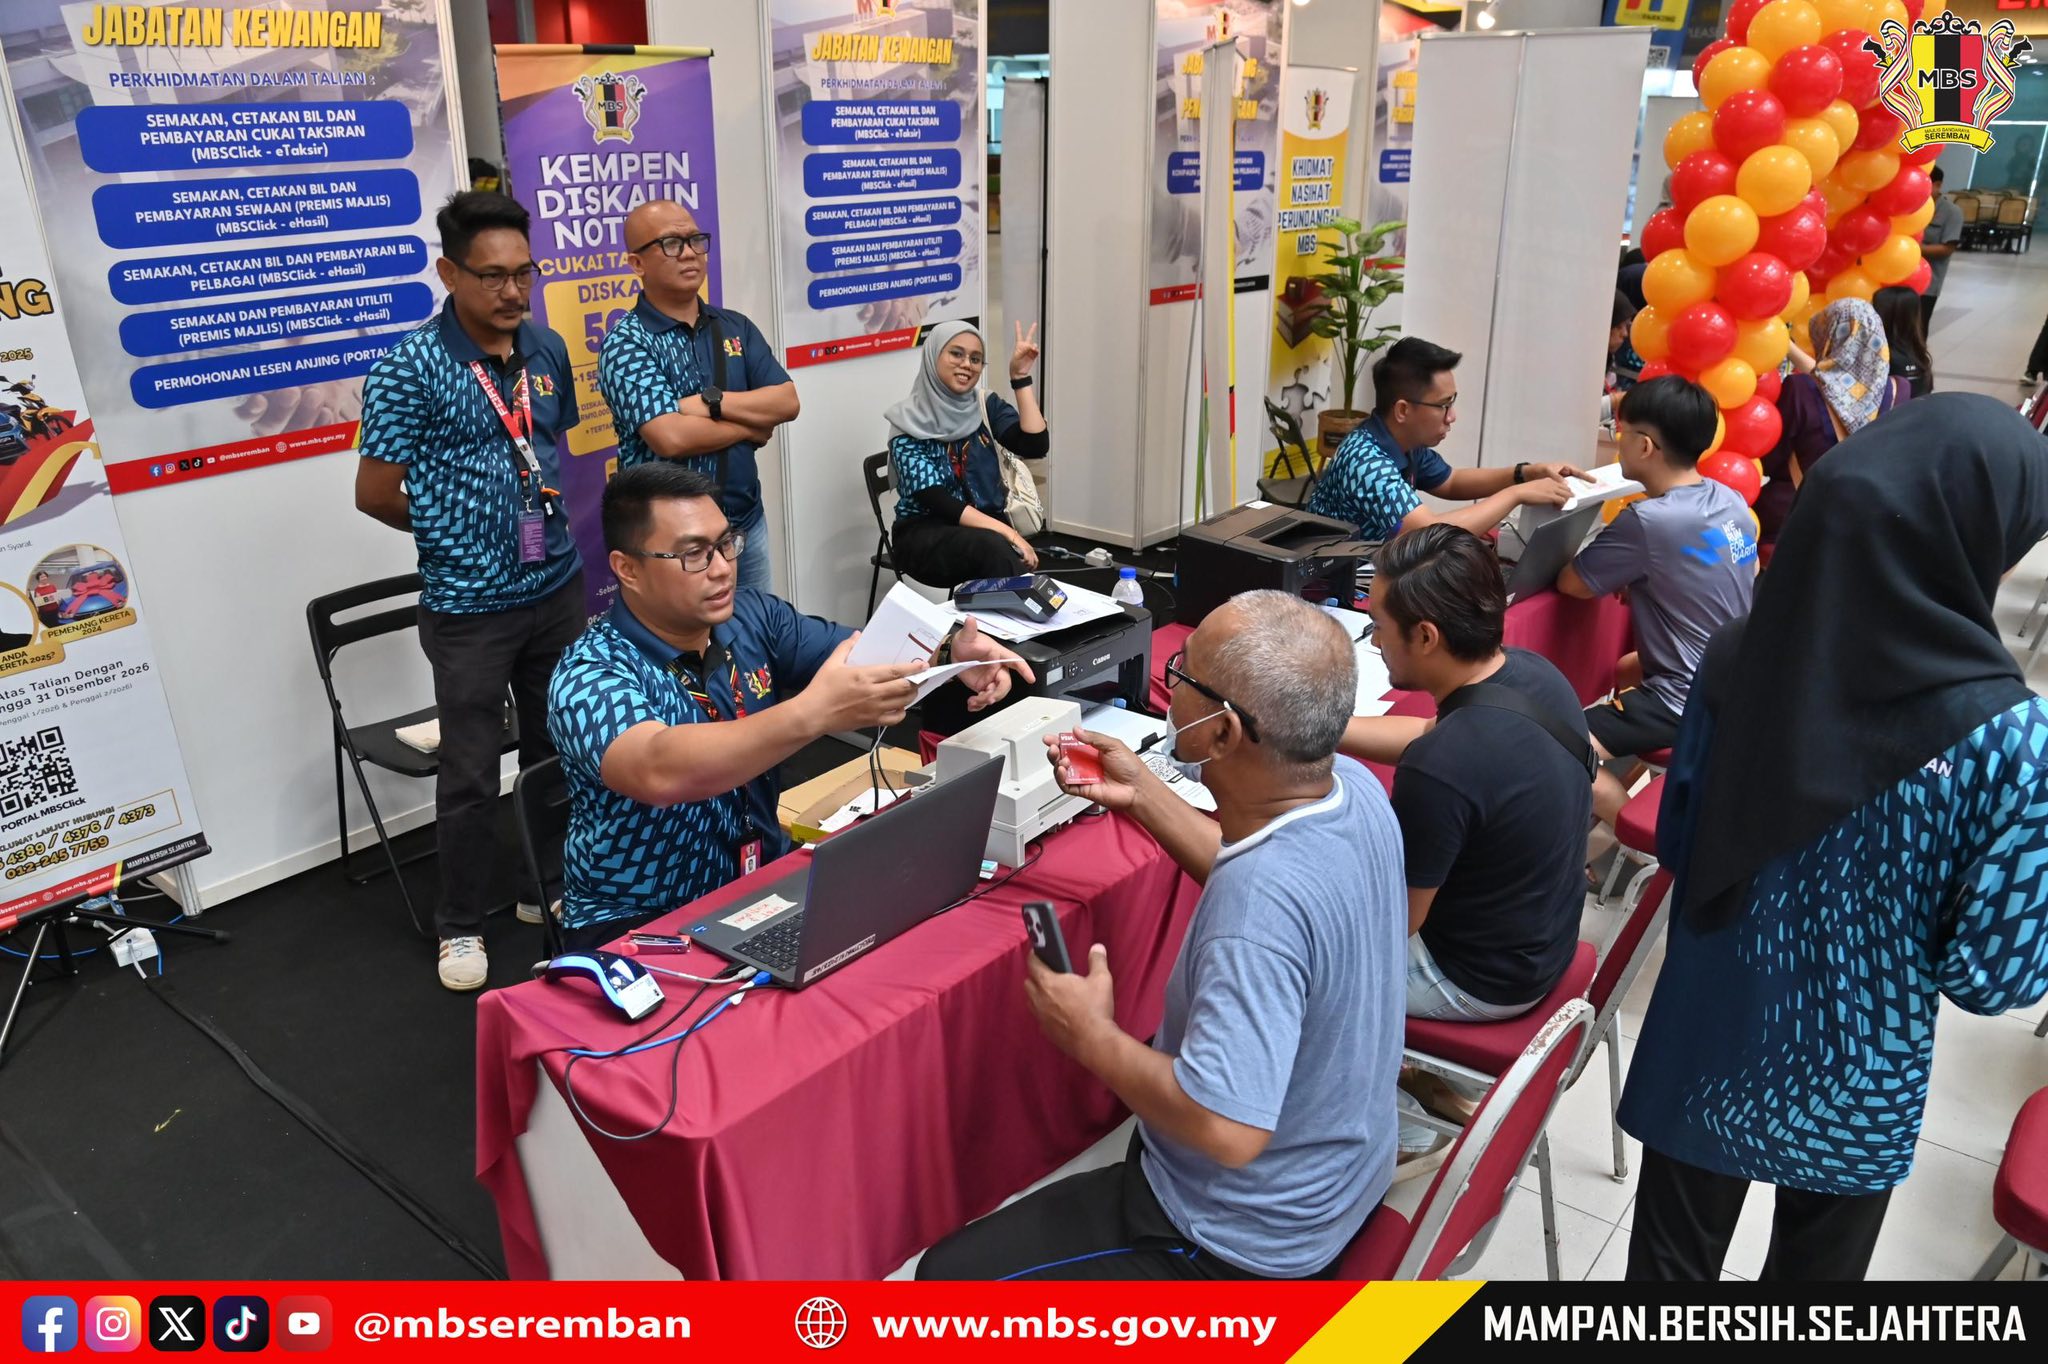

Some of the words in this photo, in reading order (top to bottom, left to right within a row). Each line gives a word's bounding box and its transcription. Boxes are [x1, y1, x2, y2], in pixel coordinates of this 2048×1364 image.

[82, 4, 223, 46] JABATAN
[232, 8, 382, 48] KEWANGAN
[813, 33, 879, 62] JABATAN
[882, 36, 953, 65] KEWANGAN
[110, 72, 246, 88] PERKHIDMATAN
[251, 72, 306, 86] DALAM
[313, 71, 367, 85] TALIAN
[821, 79, 885, 90] PERKHIDMATAN
[597, 100, 624, 112] MBS
[835, 105, 876, 117] SEMAKAN,
[877, 105, 908, 116] CETAKAN
[910, 105, 920, 115] BIL
[921, 106, 936, 116] DAN
[146, 113, 228, 128] SEMAKAN,
[232, 111, 300, 125] CETAKAN
[304, 110, 324, 123] BIL
[327, 110, 356, 122] DAN
[831, 117, 883, 128] PEMBAYARAN
[885, 117, 906, 127] CUKAI
[907, 116, 939, 127] TAKSIRAN
[140, 130, 248, 145] PEMBAYARAN
[251, 128, 295, 142] CUKAI
[298, 125, 365, 139] TAKSIRAN
[191, 147, 262, 164] (MBSClick
[275, 144, 329, 159] eTaksir)
[842, 159, 878, 169] SEMAKAN,
[879, 157, 908, 167] CETAKAN
[909, 157, 918, 165] BIL
[918, 156, 932, 165] DAN
[540, 152, 690, 186] KEMPEN
[823, 169, 871, 181] PEMBAYARAN
[873, 168, 900, 179] SEWAAN
[1293, 158, 1333, 177] KHIDMAT
[172, 188, 244, 204] SEMAKAN,
[247, 185, 307, 198] CETAKAN
[310, 183, 328, 195] BIL
[330, 182, 356, 193] DAN
[1291, 184, 1331, 202] NASIHAT
[135, 205, 232, 224] PEMBAYARAN
[235, 202, 292, 216] SEWAAN
[295, 199, 343, 214] (PREMIS
[346, 195, 391, 209] MAJLIS)
[812, 210, 850, 221] SEMAKAN,
[851, 207, 882, 217] CETAKAN
[883, 206, 892, 215] BIL
[893, 205, 907, 214] DAN
[908, 203, 947, 213] PEMBAYARAN
[948, 202, 956, 210] BIL
[216, 219, 277, 237] (MBSClick
[289, 214, 329, 229] eHasil)
[554, 215, 627, 250] NOT
[845, 219, 878, 230] PELBAGAI
[832, 245, 865, 256] SEMAKAN
[866, 244, 881, 253] DAN
[882, 240, 923, 252] PEMBAYARAN
[1297, 234, 1316, 253] MBS
[123, 264, 197, 282] SEMAKAN,
[200, 259, 262, 274] CETAKAN
[265, 255, 283, 268] BIL
[286, 252, 313, 266] DAN
[316, 245, 396, 263] PEMBAYARAN
[399, 243, 415, 255] BIL
[537, 254, 604, 277] CUKAI
[190, 276, 255, 291] PELBAGAI
[258, 269, 317, 287] (MBSClick
[328, 263, 366, 277] eHasil)
[578, 279, 642, 304] DISKA
[819, 284, 868, 298] PERMOHONAN
[869, 281, 889, 293] LESEN
[890, 279, 913, 290] ANJING
[0, 278, 54, 321] NG
[170, 312, 236, 330] SEMAKAN
[239, 309, 267, 322] DAN
[270, 300, 353, 318] PEMBAYARAN
[356, 293, 392, 307] UTILITI
[178, 330, 231, 347] (PREMIS
[234, 323, 283, 340] MAJLIS)
[286, 316, 343, 334] (MBSClick
[354, 308, 391, 324] eHasil)
[0, 348, 33, 363] 2025
[154, 367, 251, 391] PERMOHONAN
[254, 362, 292, 377] LESEN
[295, 355, 340, 372] ANJING
[219, 446, 270, 462] @mbseremban
[289, 432, 346, 449] www.mbs.gov.my
[1722, 520, 1735, 532] WE
[1730, 539, 1745, 553] FOR
[1323, 559, 1334, 568] Canon
[48, 620, 98, 638] PEMENANG
[98, 611, 131, 625] KERETA
[82, 625, 102, 636] 2024
[0, 658, 29, 671] ERETA
[1, 651, 28, 662] ANDA
[1092, 653, 1111, 666] Canon
[29, 677, 71, 692] Talian
[75, 660, 124, 680] Dengan
[0, 698, 32, 714] ngga
[36, 693, 51, 704] 31
[55, 673, 117, 698] Disember
[122, 662, 150, 679] 2026
[70, 694, 102, 707] Penggal
[1924, 757, 1954, 778] AN
[1, 812, 38, 833] PORTAL
[40, 797, 87, 818] MBSClick
[36, 820, 70, 838] LANJUT
[73, 806, 115, 824] HUBUNGI
[6, 841, 46, 866] 4389
[62, 820, 102, 844] 4376
[118, 804, 156, 826] 4373
[5, 846, 69, 880] 012-245
[69, 835, 110, 858] 7759
[0, 898, 38, 914] bseremban
[55, 871, 110, 896] www.mbs.gov.my
